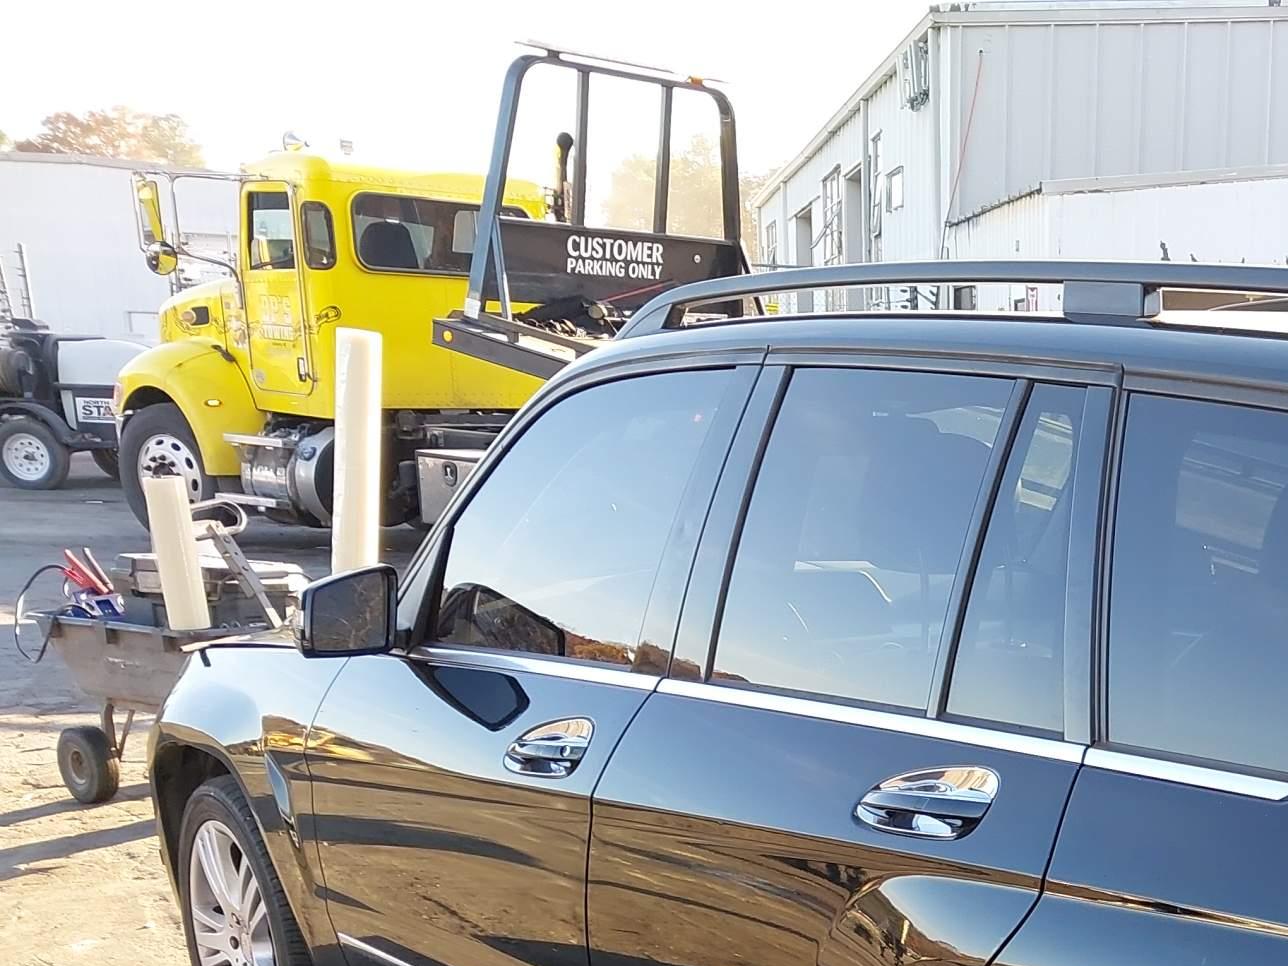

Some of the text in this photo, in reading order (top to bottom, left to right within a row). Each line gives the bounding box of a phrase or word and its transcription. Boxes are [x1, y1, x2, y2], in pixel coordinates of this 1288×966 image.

[566, 235, 664, 264] CUSTOMER
[566, 257, 663, 280] PARKING ONLY
